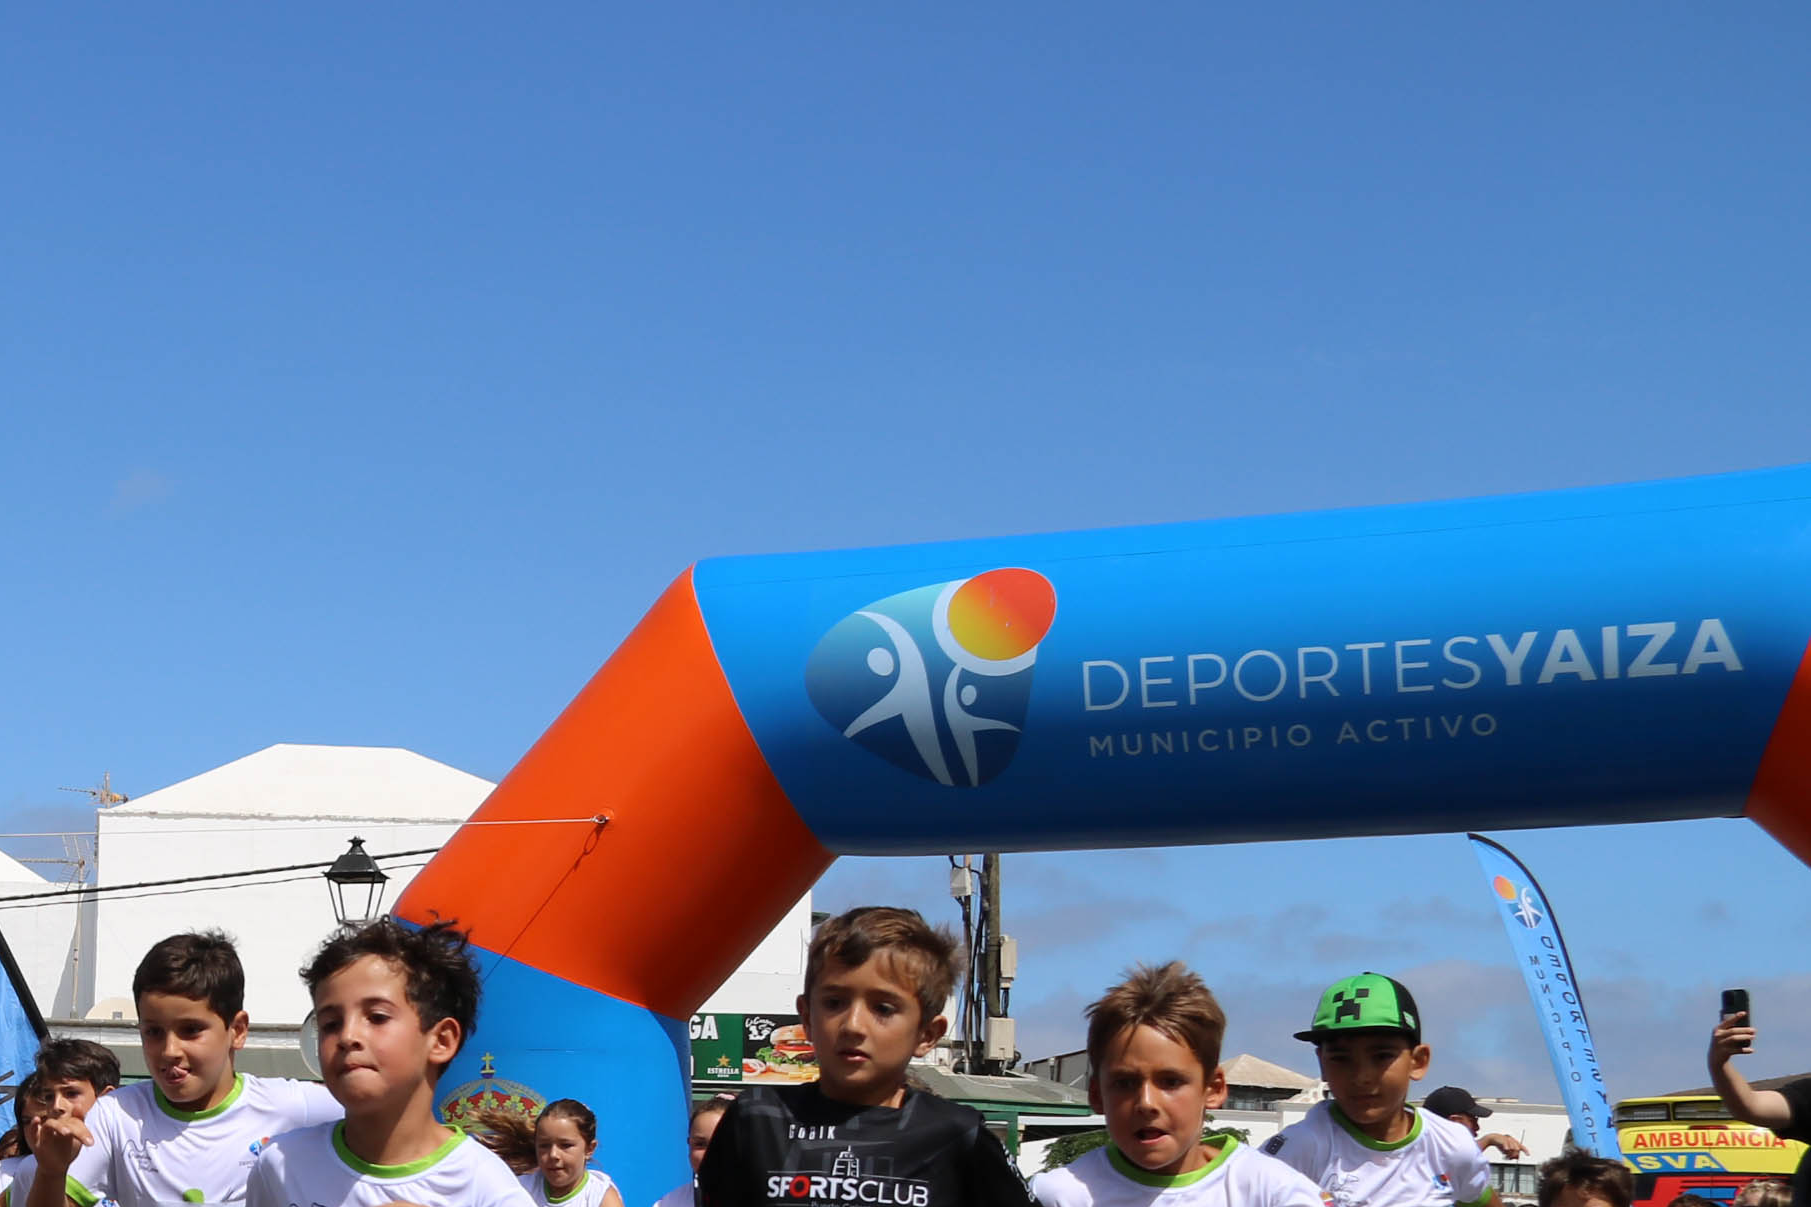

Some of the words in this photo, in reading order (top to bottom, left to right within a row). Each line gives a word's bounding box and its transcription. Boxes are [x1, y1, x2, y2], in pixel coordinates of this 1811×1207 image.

[1082, 618, 1743, 711] DEPORTESYAIZA
[1089, 724, 1311, 757] MUNICIPIO
[1336, 713, 1497, 744] ACTIVO
[1633, 1131, 1787, 1149] AMBULANCIA
[1635, 1155, 1721, 1170] SVA
[767, 1175, 929, 1207] SPORTSCLUB
